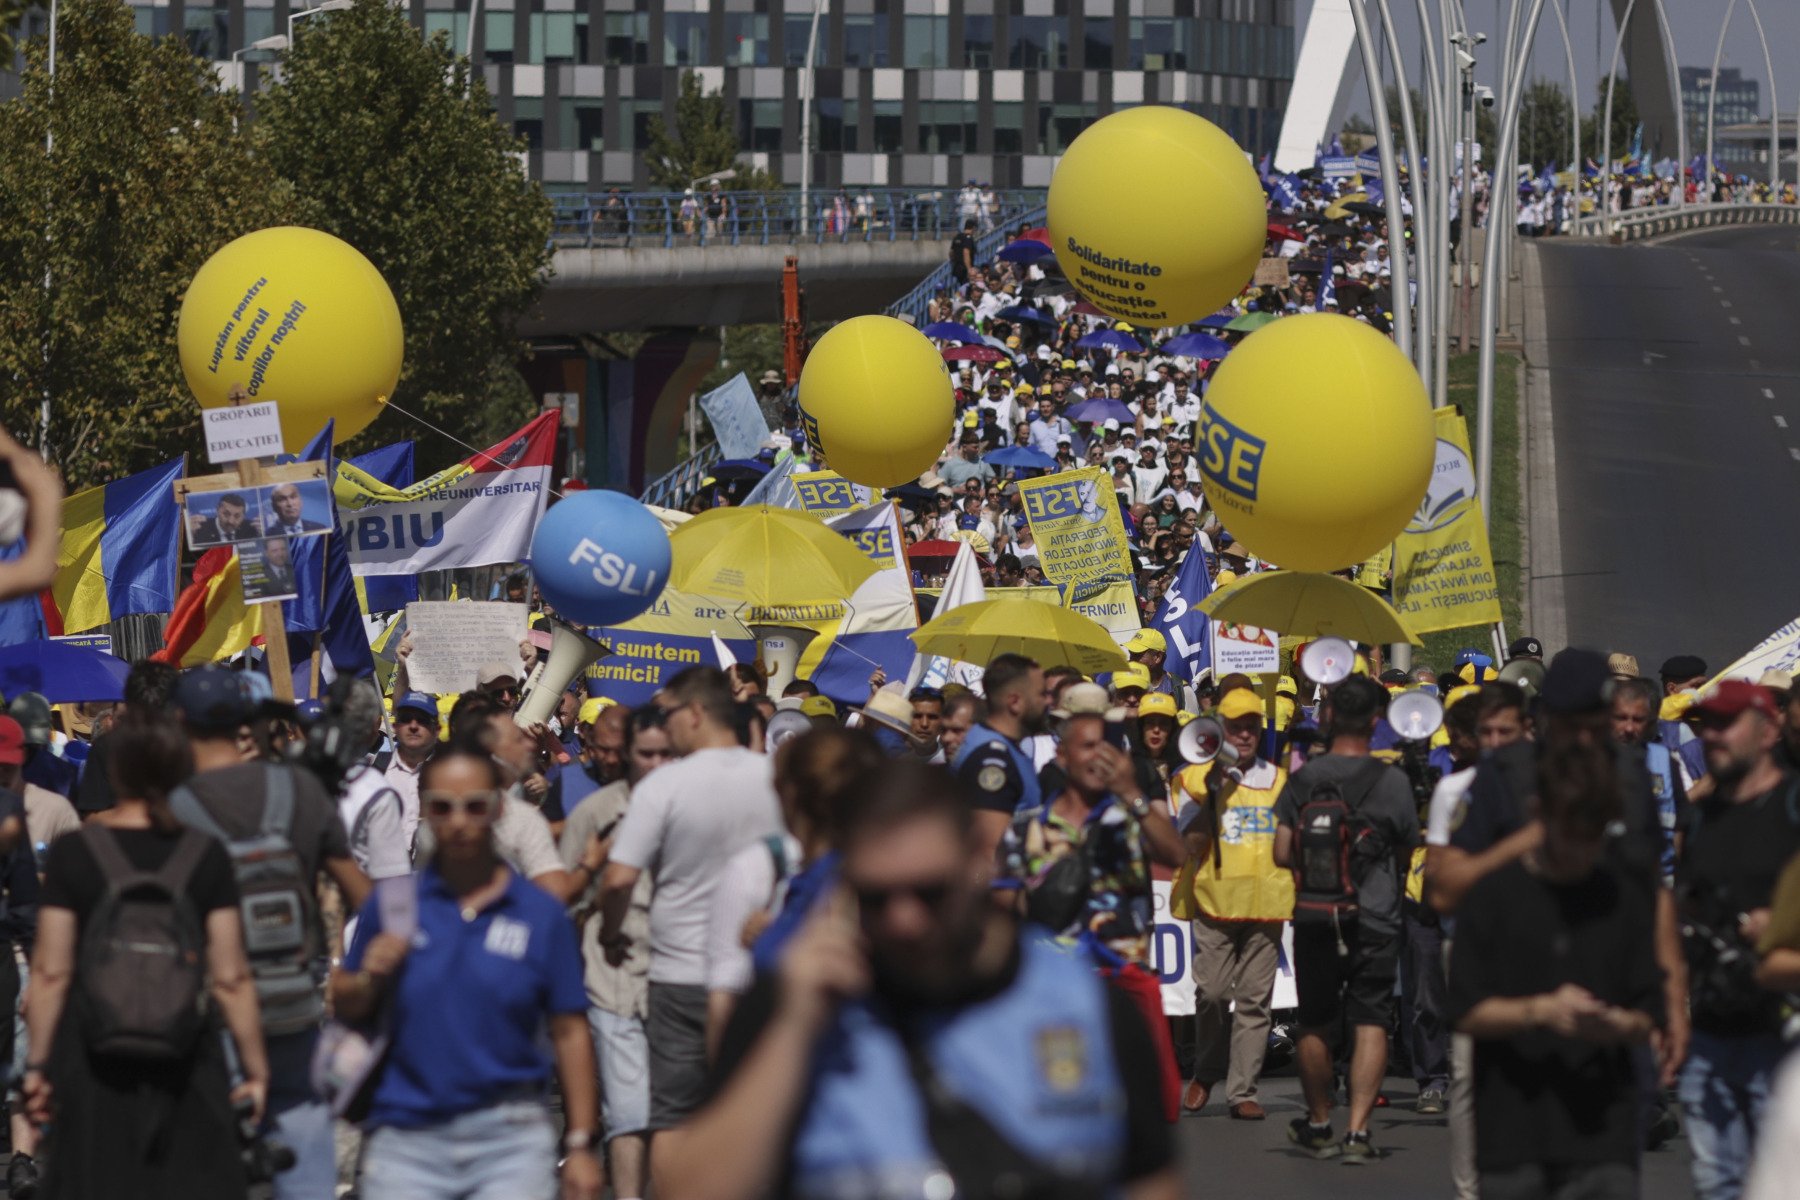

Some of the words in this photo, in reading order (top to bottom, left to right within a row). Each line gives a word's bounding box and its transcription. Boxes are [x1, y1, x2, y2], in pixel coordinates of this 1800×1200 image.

[1067, 237, 1162, 277] Solidaritate
[1080, 265, 1130, 289] pentru
[1134, 281, 1146, 291] o
[207, 321, 235, 374] Luptăm
[231, 276, 268, 322] pentru
[234, 307, 270, 362] viitorul
[247, 344, 275, 397] copiilor
[270, 300, 307, 346] noștri!
[209, 405, 272, 423] GROPARII
[210, 434, 279, 452] EDUCAȚIEI
[568, 537, 657, 596] FSLI
[694, 606, 727, 620] are
[750, 604, 845, 621] PRIORITATE!
[616, 642, 700, 663] suntem
